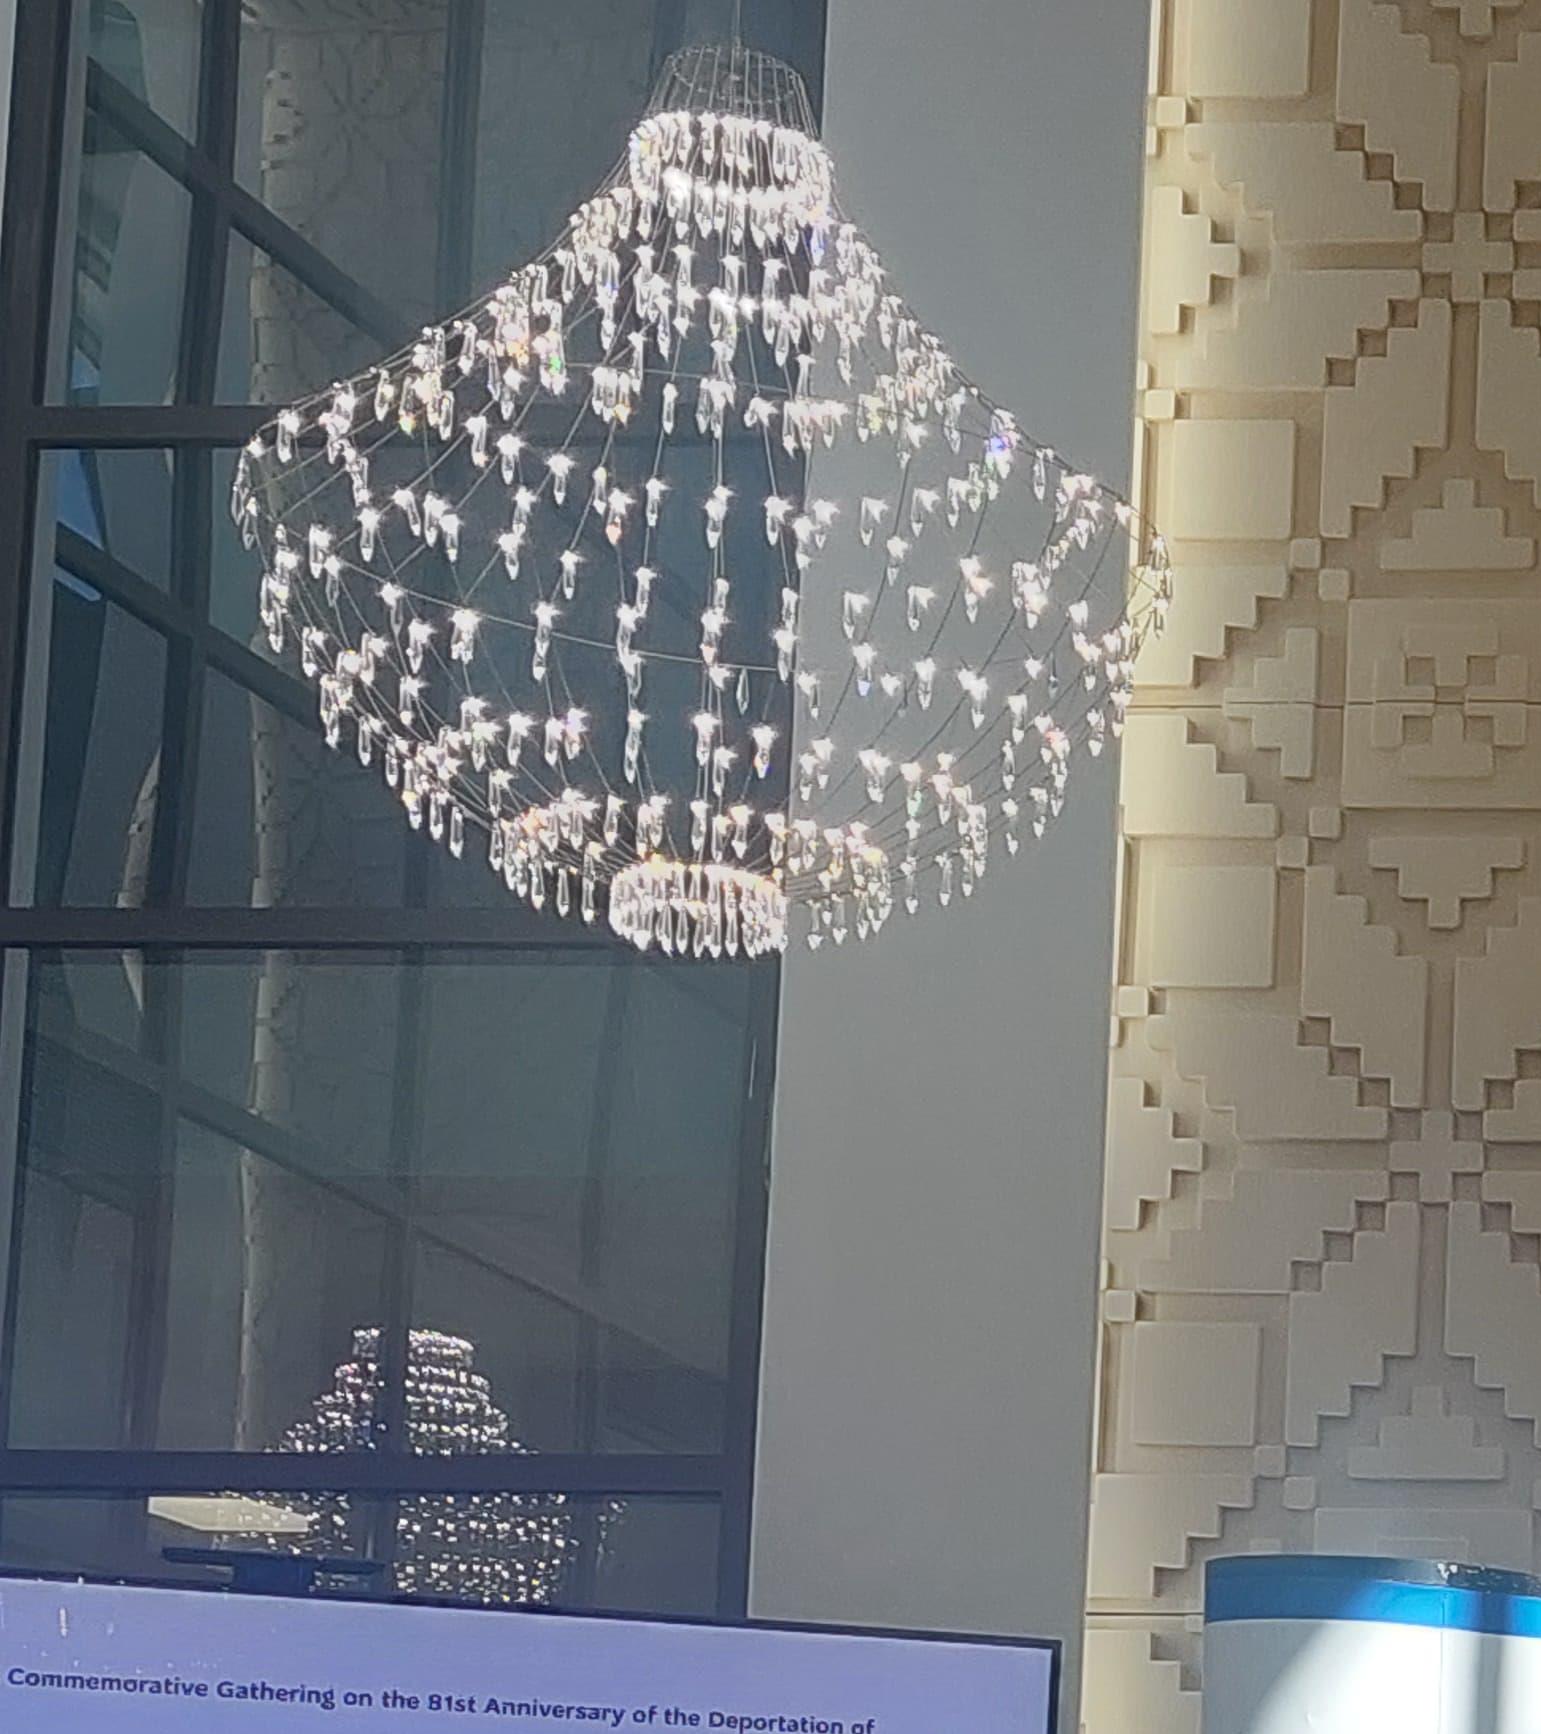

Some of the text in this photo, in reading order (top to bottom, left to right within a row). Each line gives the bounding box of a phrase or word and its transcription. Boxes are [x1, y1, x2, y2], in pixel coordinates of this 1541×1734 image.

[8, 1668, 208, 1698] Commemorative
[217, 1681, 336, 1710] Gathering
[344, 1692, 373, 1708] on
[382, 1691, 420, 1710] the
[428, 1694, 476, 1714] 81st
[484, 1697, 625, 1727] Anniversary
[632, 1705, 658, 1724] of
[665, 1707, 700, 1726] the
